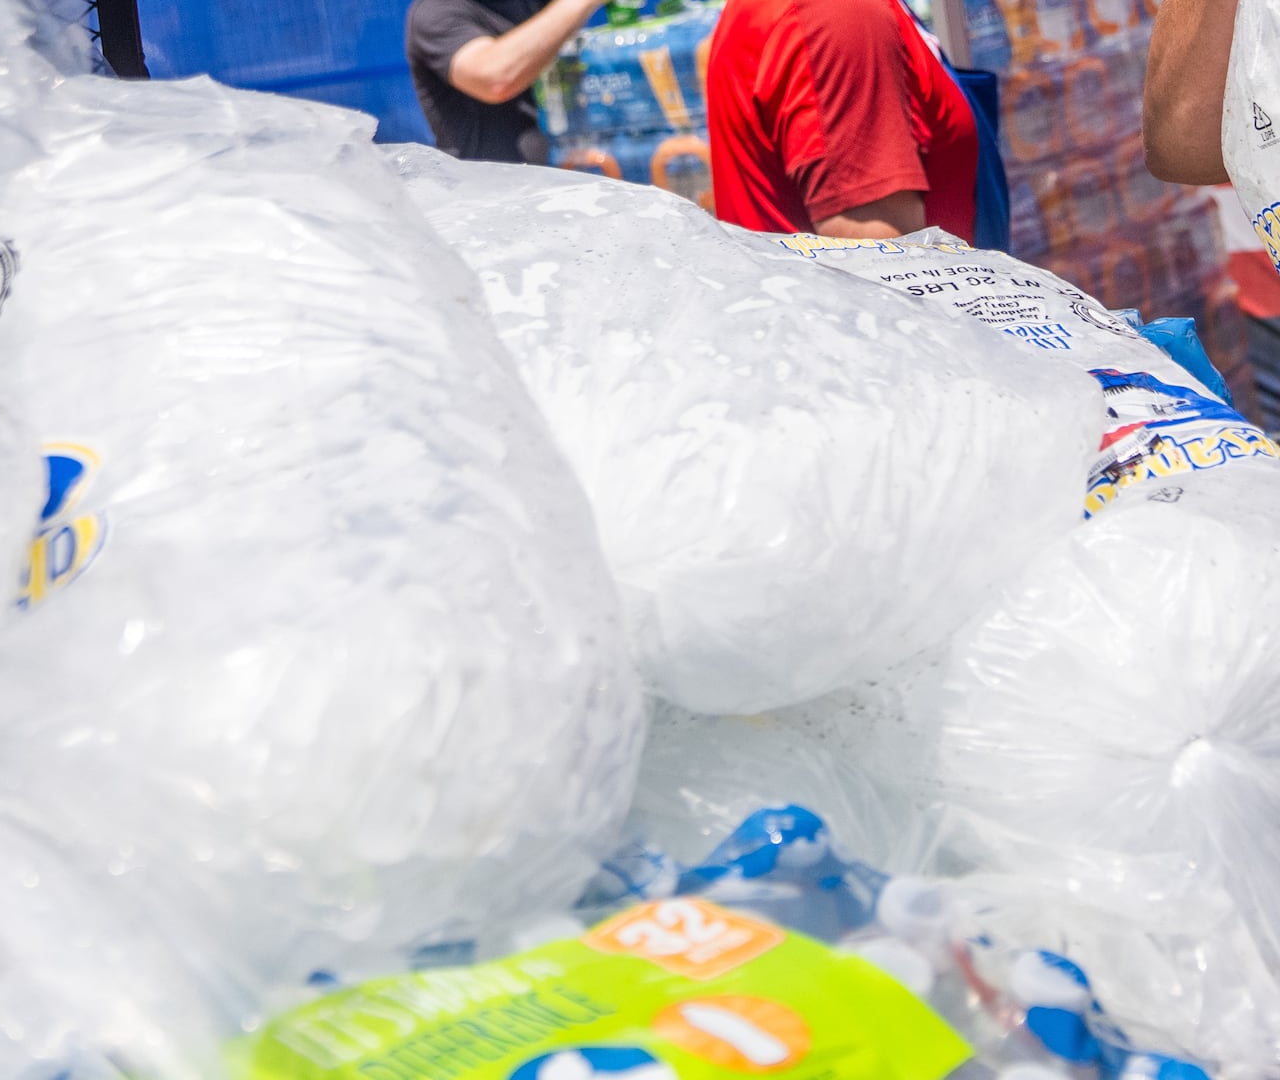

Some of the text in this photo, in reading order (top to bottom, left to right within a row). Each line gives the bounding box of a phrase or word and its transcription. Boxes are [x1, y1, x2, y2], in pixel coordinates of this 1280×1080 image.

[880, 266, 995, 282] MADE IN USA
[906, 282, 959, 296] LBS
